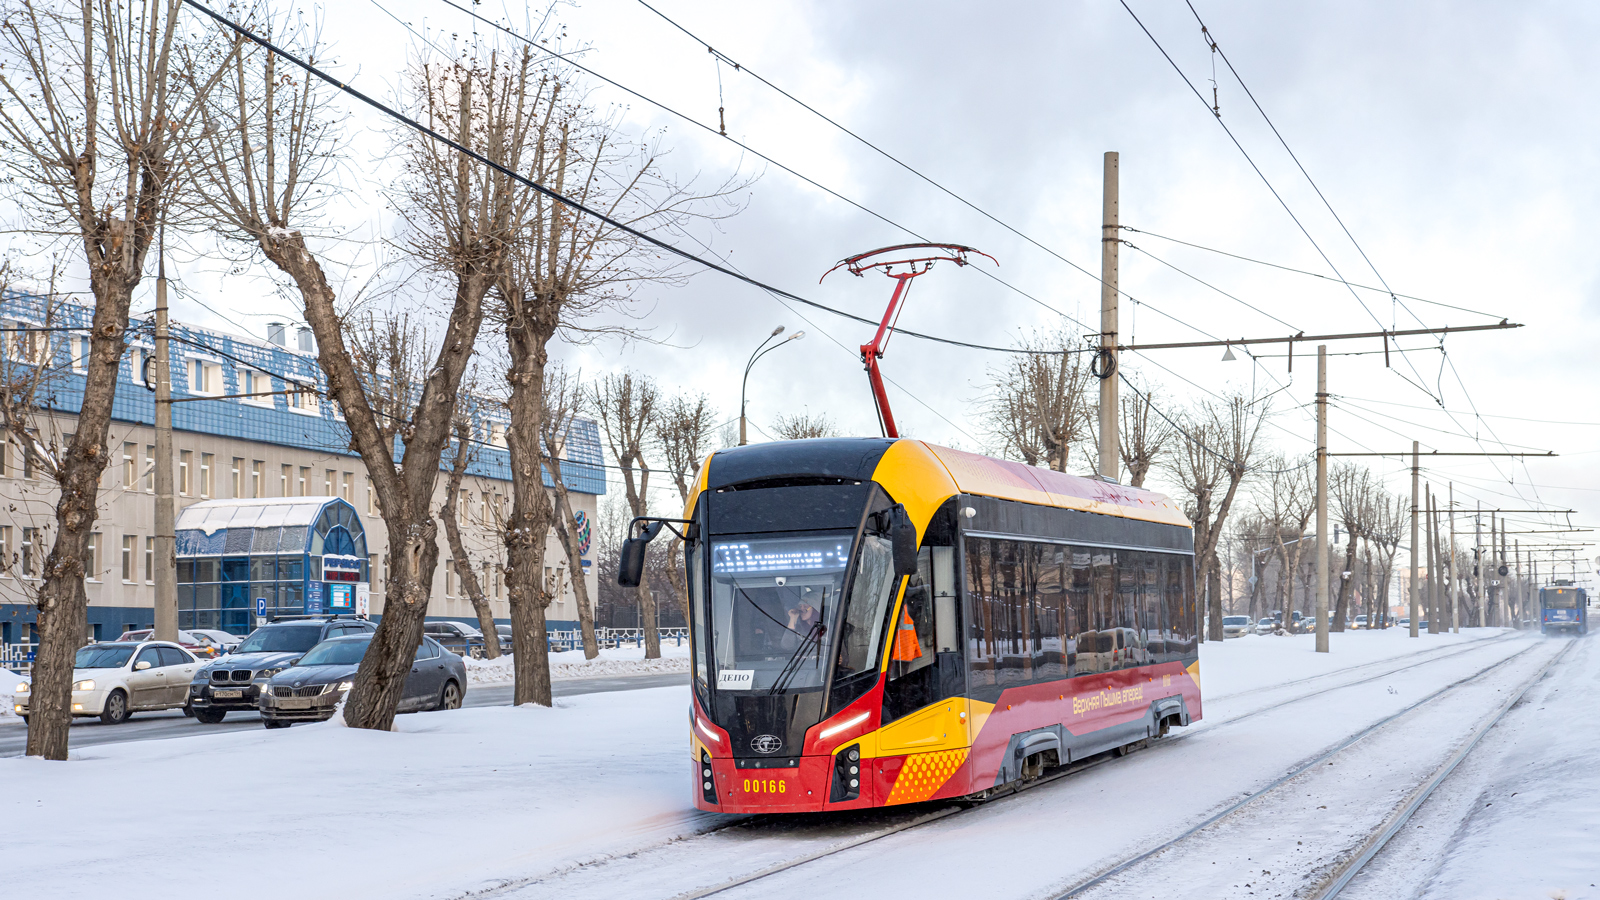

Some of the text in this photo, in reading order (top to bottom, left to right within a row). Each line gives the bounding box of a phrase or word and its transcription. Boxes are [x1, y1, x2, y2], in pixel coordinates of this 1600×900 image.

[258, 600, 265, 615] P
[719, 674, 750, 682] ДЕПО
[743, 779, 786, 793] 00166
